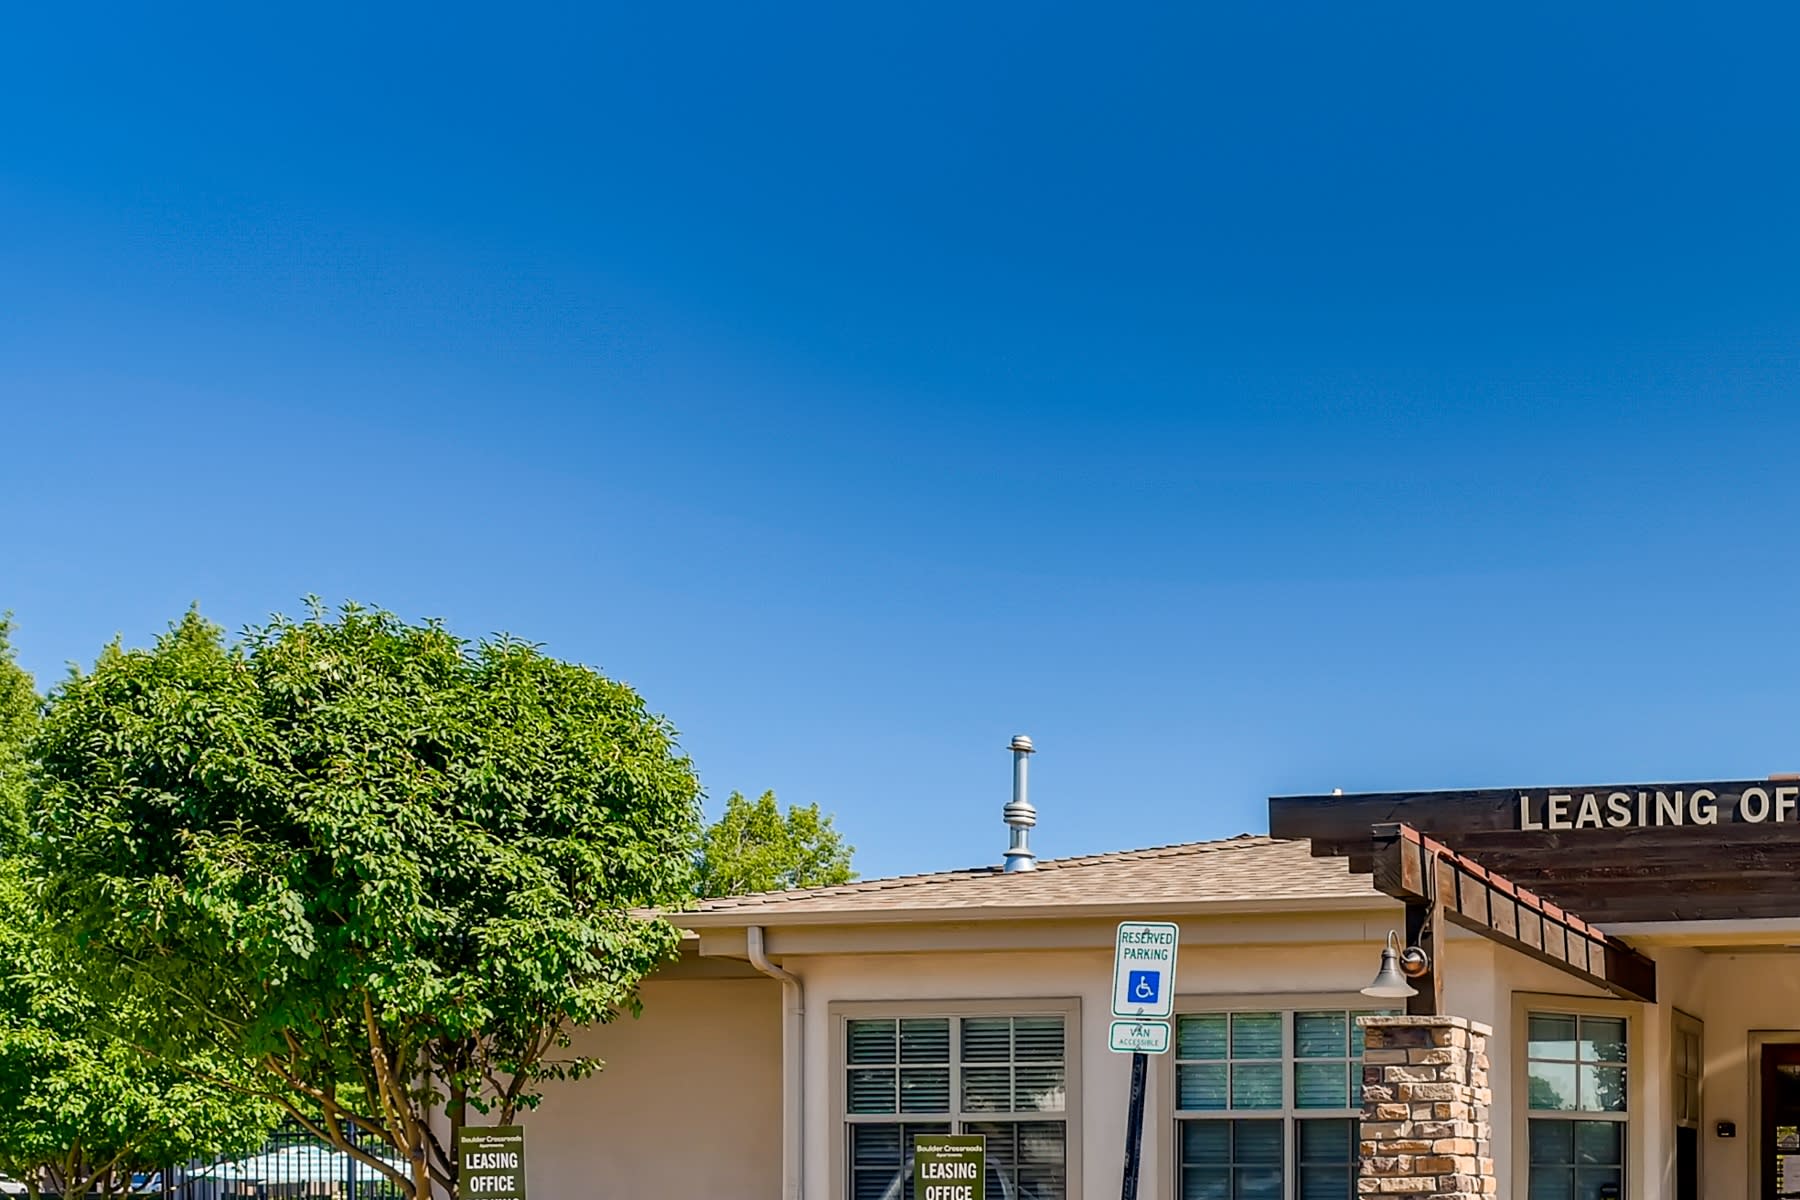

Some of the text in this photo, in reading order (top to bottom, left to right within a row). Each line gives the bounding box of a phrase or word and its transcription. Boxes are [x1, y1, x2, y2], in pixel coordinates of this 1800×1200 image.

[1520, 788, 1718, 832] LEASING
[1121, 931, 1173, 945] RESERVED
[1123, 947, 1168, 960] PARKING
[1130, 1027, 1151, 1037] VAN
[1119, 1038, 1159, 1047] ACCESSIBLE
[465, 1152, 518, 1170] LEASING
[921, 1162, 977, 1179] LEASING
[470, 1175, 515, 1192] OFFICE
